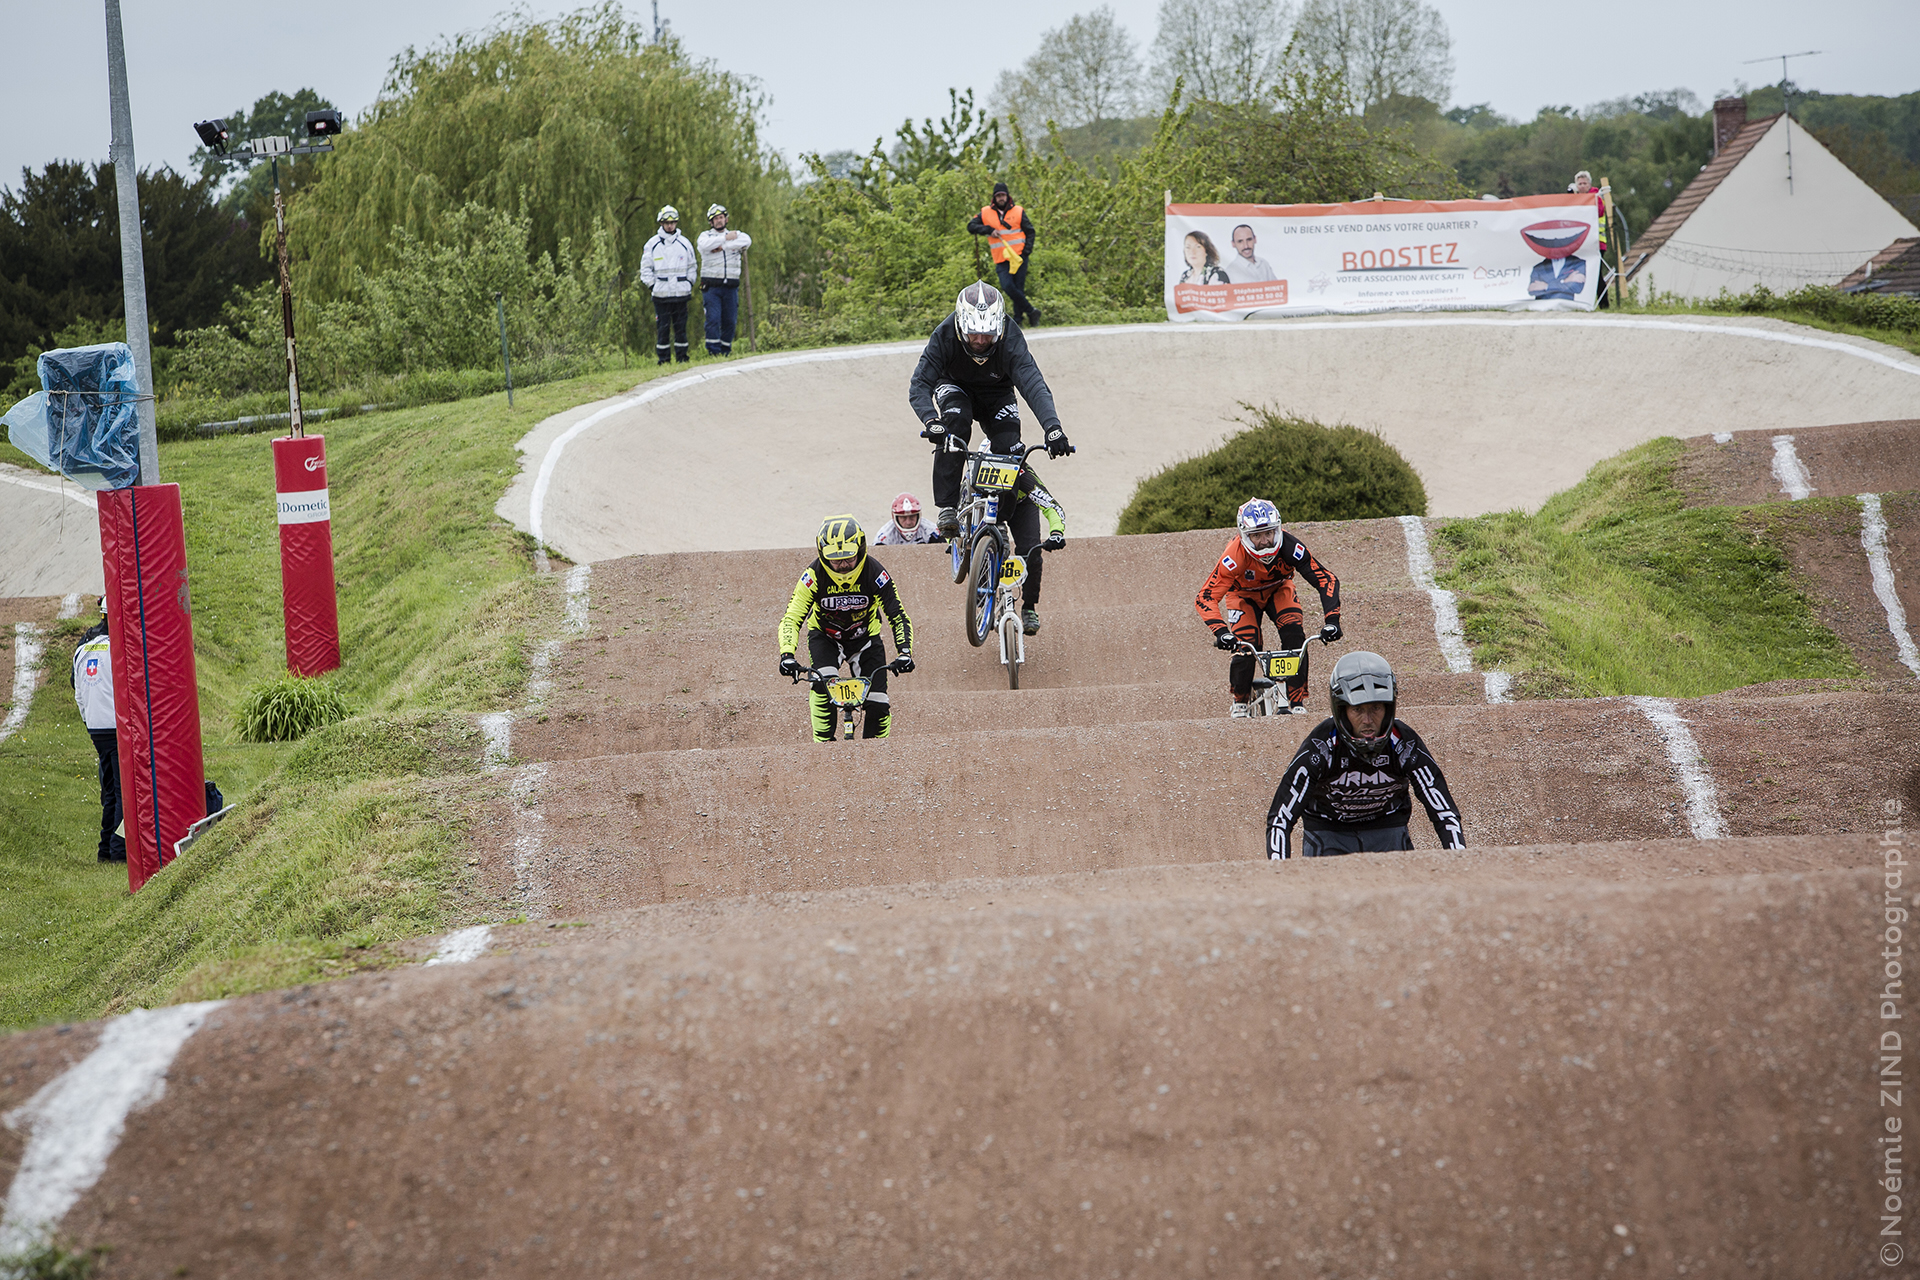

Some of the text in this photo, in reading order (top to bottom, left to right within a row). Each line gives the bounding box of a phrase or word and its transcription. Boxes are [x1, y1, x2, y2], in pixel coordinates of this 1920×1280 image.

[1283, 220, 1478, 234] UN BIEN SE VEND DANS VOTRE QUARTIER ?
[1342, 242, 1459, 271] BOOSTEZ
[1364, 274, 1417, 283] ASSOCIATION
[1487, 266, 1521, 279] SAFTI
[1358, 290, 1393, 298] Informez
[1411, 287, 1454, 296] conseillers
[978, 467, 1001, 485] 06
[282, 499, 327, 513] Dometic
[307, 511, 328, 519] GROUP
[1271, 765, 1310, 860] CHAS
[1412, 765, 1466, 850] HASE
